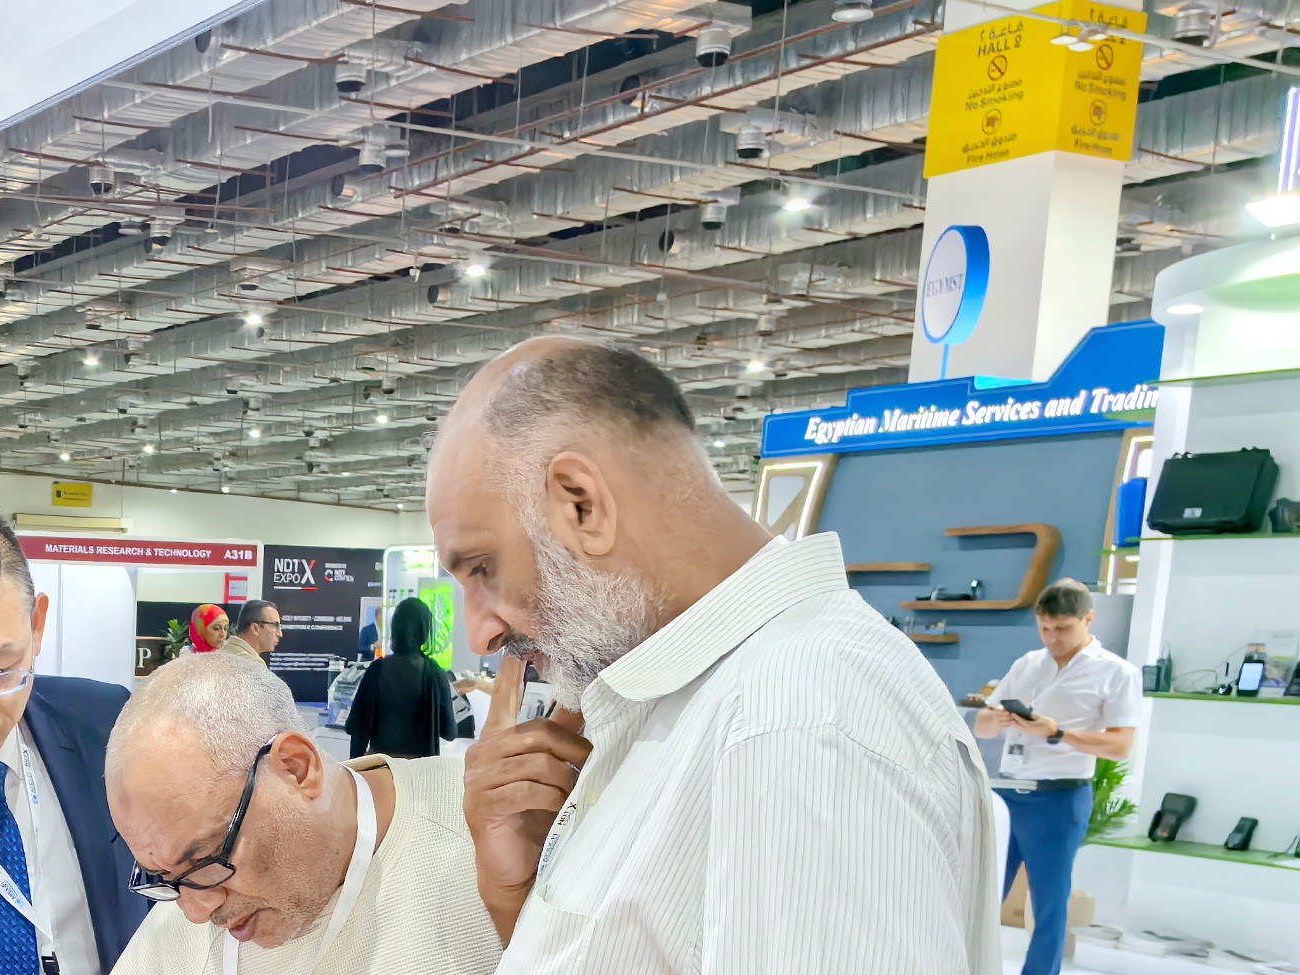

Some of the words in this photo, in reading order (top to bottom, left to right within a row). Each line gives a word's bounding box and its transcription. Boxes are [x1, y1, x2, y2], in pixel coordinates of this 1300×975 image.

[978, 38, 1011, 57] HALL
[805, 416, 876, 445] Egyptian
[879, 409, 960, 433] Maritime
[962, 397, 1041, 427] Services
[1044, 391, 1087, 418] and
[1090, 384, 1159, 413] Tradin
[45, 544, 94, 554] MATERIALS
[96, 546, 144, 556] RESEARCH
[146, 547, 152, 556] &
[153, 548, 212, 558] TECHNOLOGY
[224, 550, 253, 560] A31B
[274, 559, 301, 572] NDT
[300, 559, 316, 584] X
[274, 573, 300, 583] EXPO
